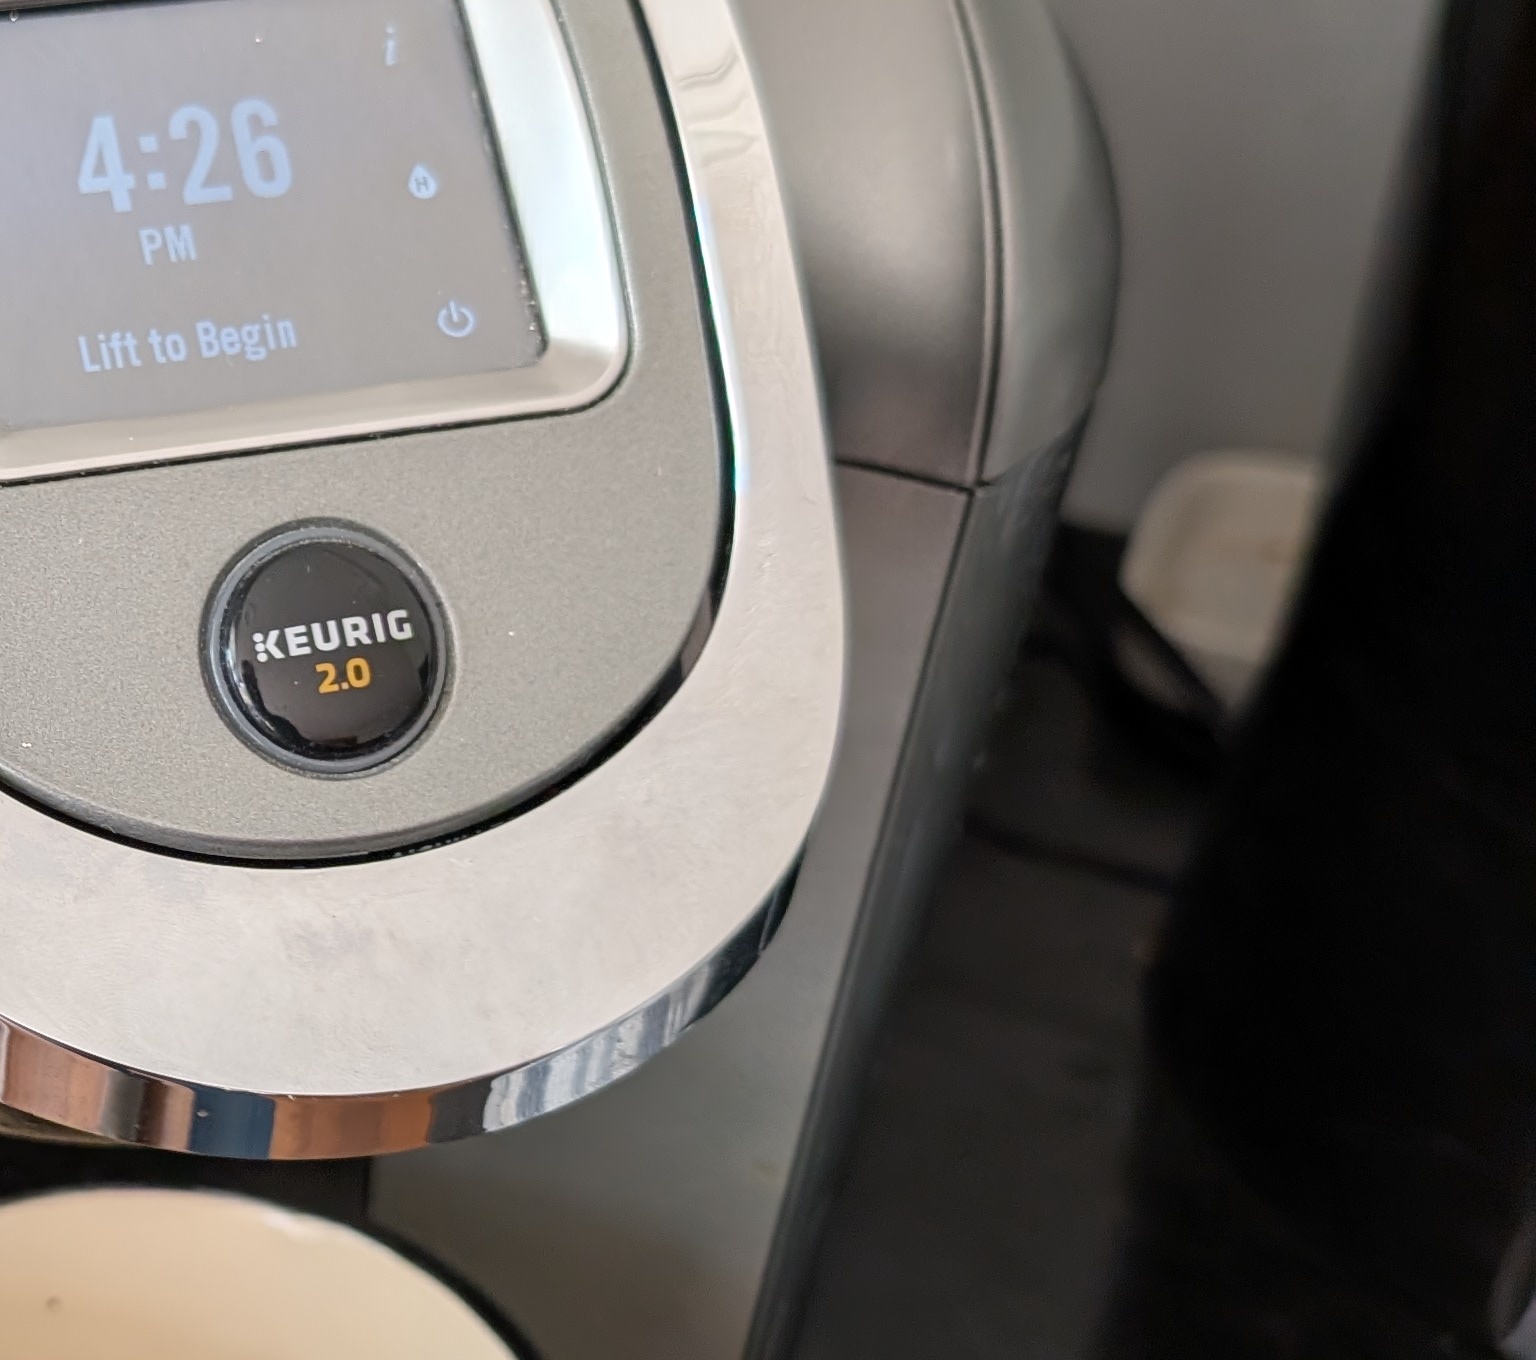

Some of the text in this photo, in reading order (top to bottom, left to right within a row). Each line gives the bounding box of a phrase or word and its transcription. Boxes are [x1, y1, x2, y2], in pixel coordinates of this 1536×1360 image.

[77, 97, 293, 214] 4:26
[138, 224, 197, 266] PM
[77, 313, 298, 373] Lift to Begin
[252, 609, 414, 662] KEURIG
[315, 657, 372, 694] 2.0
